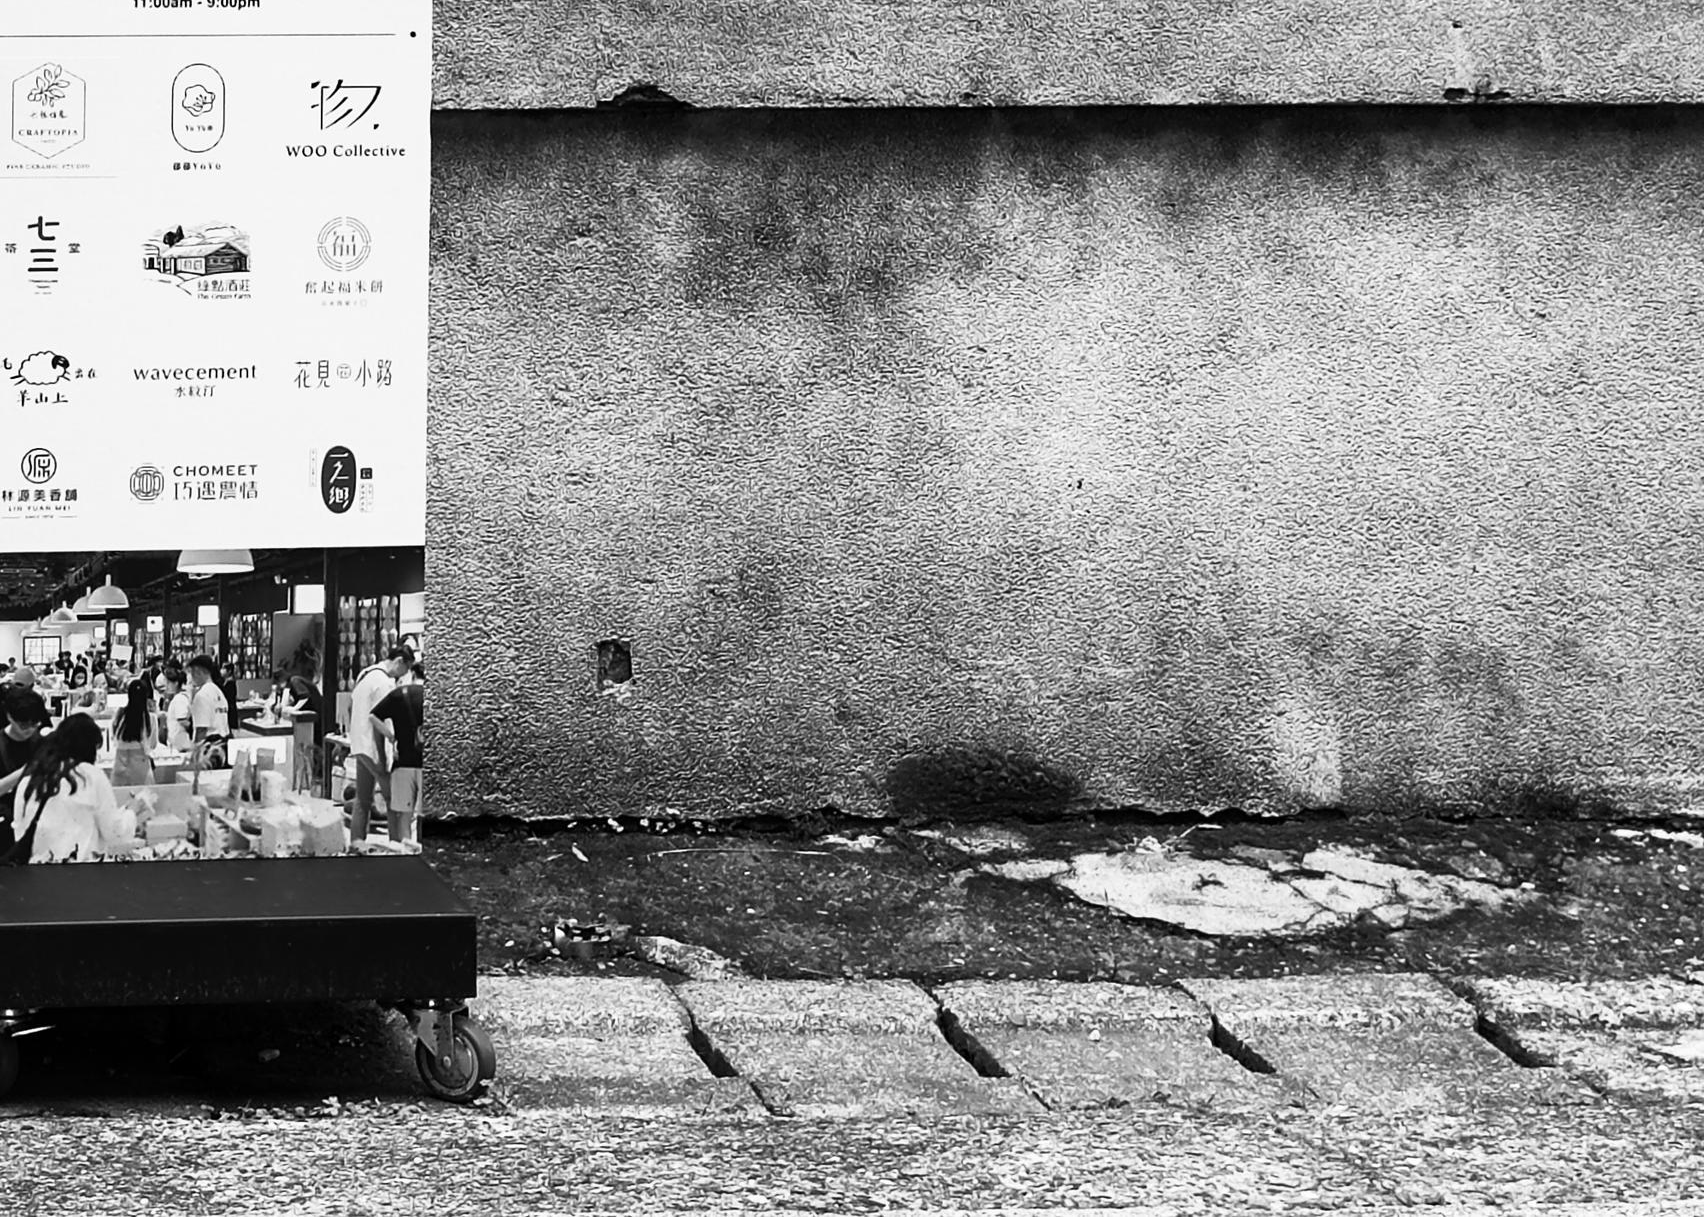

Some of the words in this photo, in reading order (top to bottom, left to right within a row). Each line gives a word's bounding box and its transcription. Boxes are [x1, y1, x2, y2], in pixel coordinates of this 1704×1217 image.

[286, 144, 327, 158] WOO
[333, 144, 406, 158] Collective
[133, 364, 256, 381] wavecement
[172, 464, 258, 477] CHOMEET
